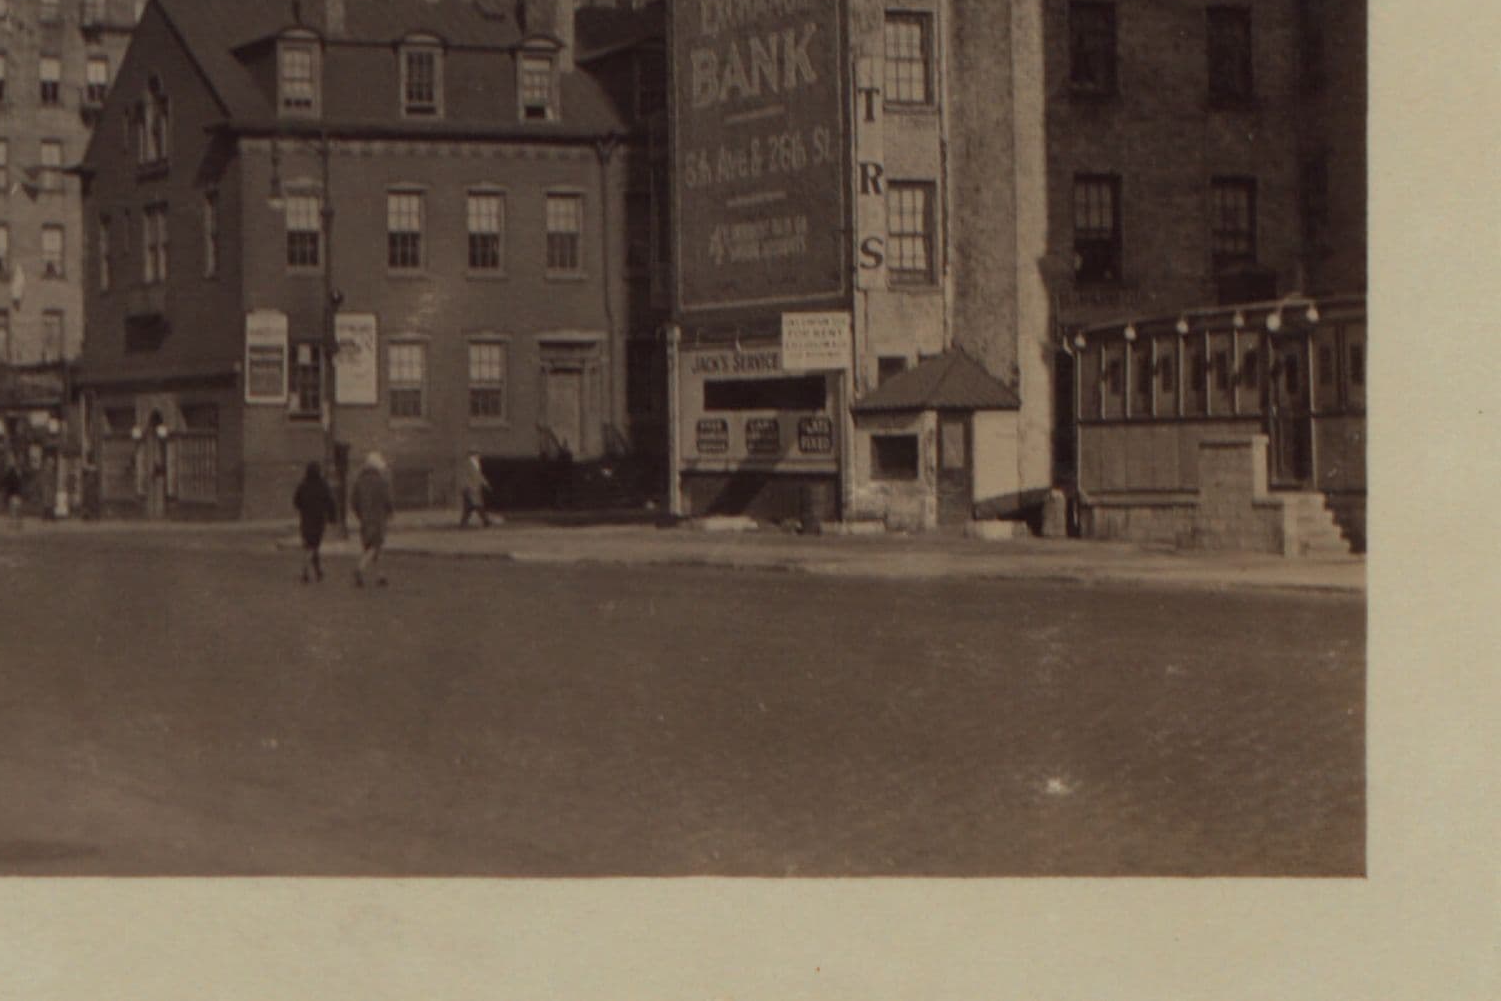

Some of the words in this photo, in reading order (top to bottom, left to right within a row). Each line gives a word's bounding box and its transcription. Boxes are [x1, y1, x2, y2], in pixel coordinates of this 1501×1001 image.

[690, 23, 818, 109] BANK
[691, 353, 730, 375] JACK'S
[732, 350, 779, 373] SERVICE
